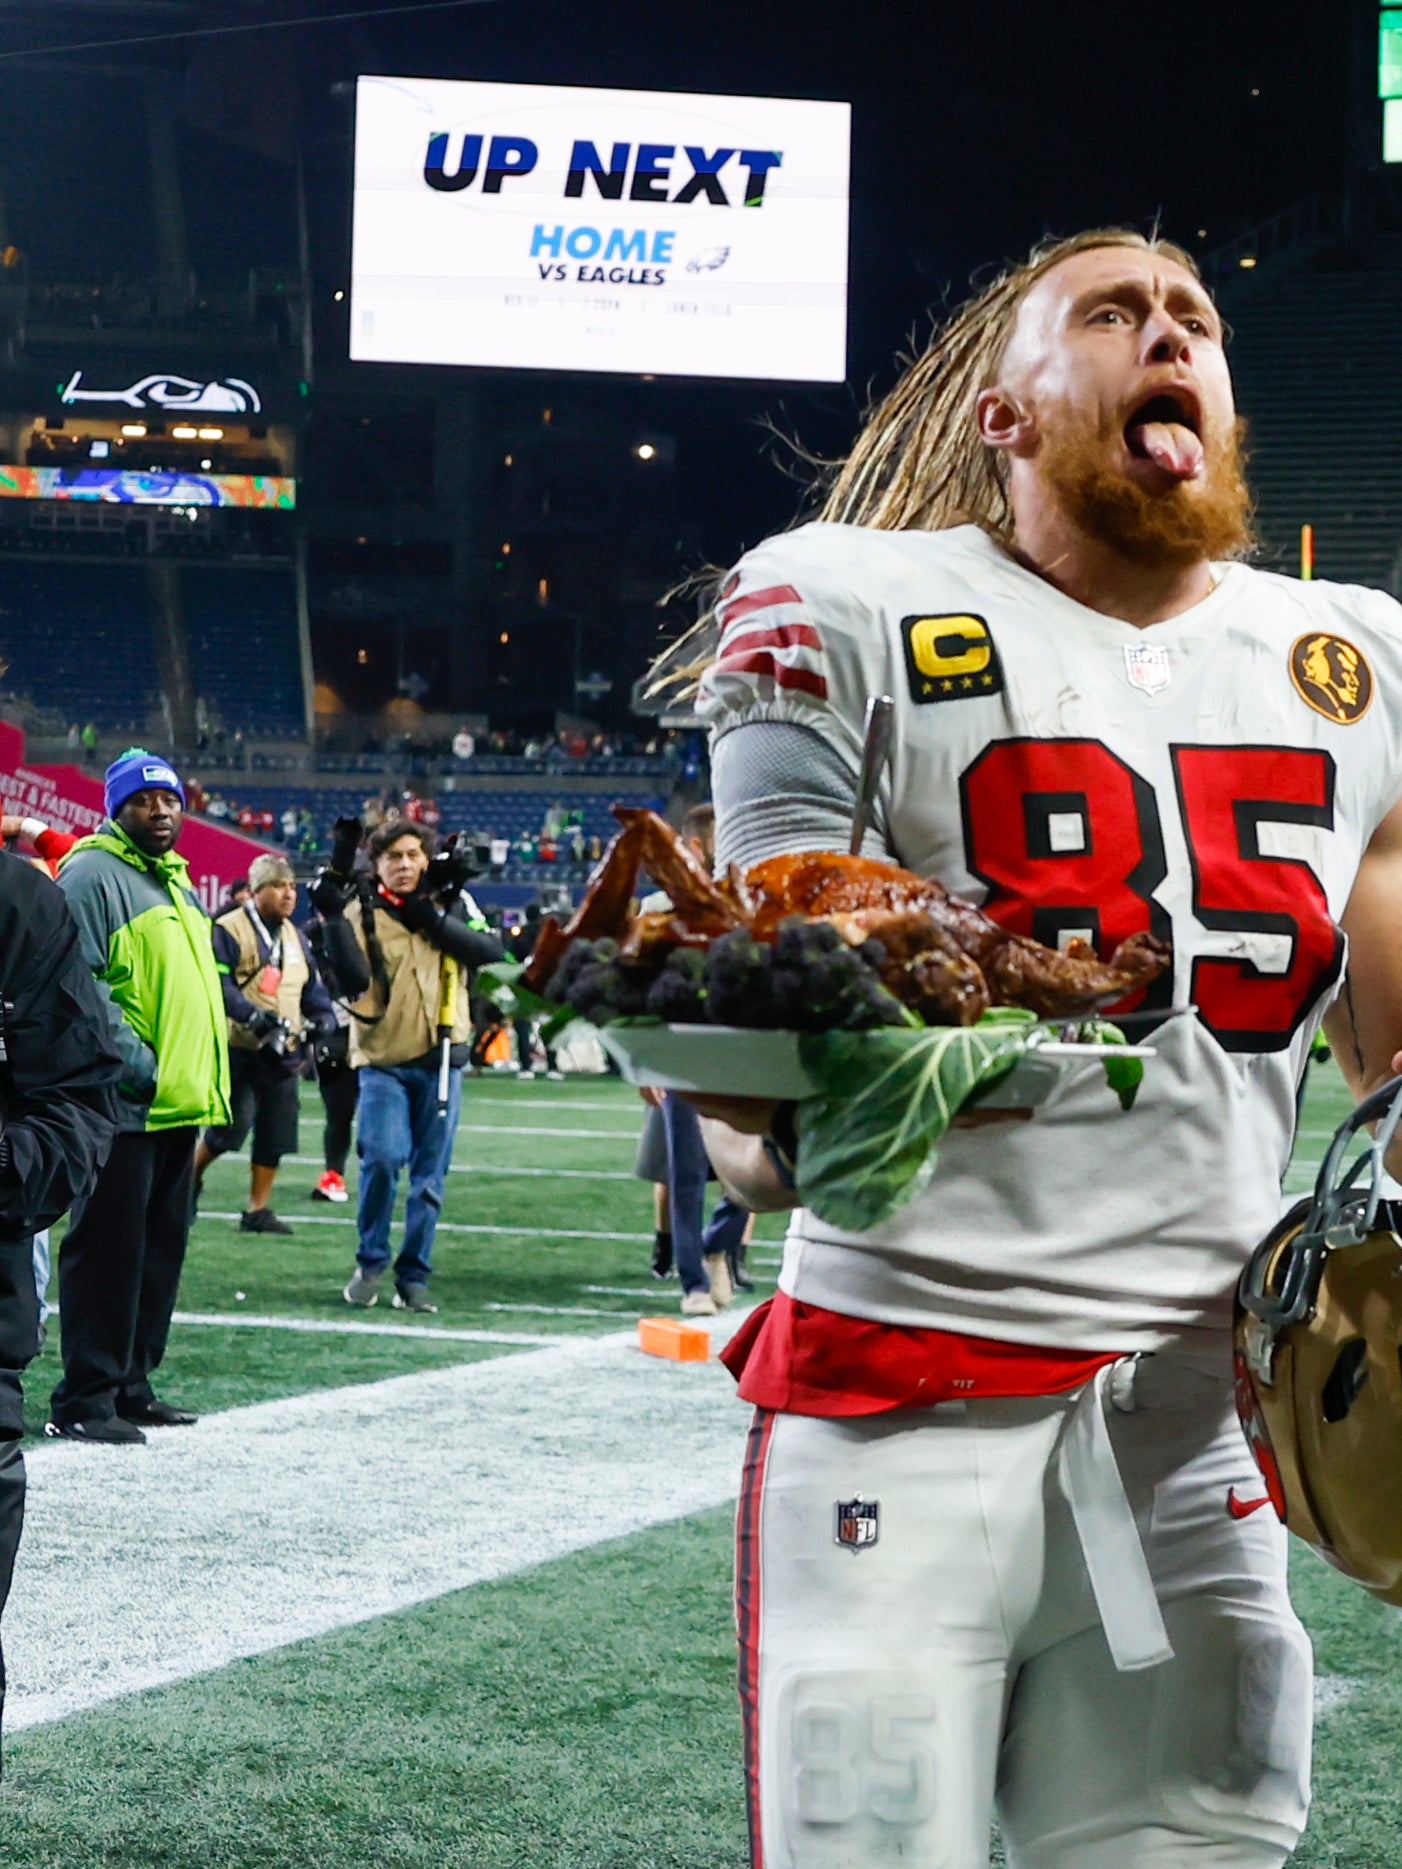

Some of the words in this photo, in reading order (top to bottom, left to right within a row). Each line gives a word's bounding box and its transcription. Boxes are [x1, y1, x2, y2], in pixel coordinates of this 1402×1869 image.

[423, 131, 538, 193] UP
[564, 140, 783, 207] NEXT
[529, 224, 677, 263] HOME
[538, 264, 566, 281] VS
[577, 266, 665, 285] EAGLES
[910, 615, 990, 678] C
[958, 737, 1349, 1054] 85
[841, 1518, 877, 1544] NFL
